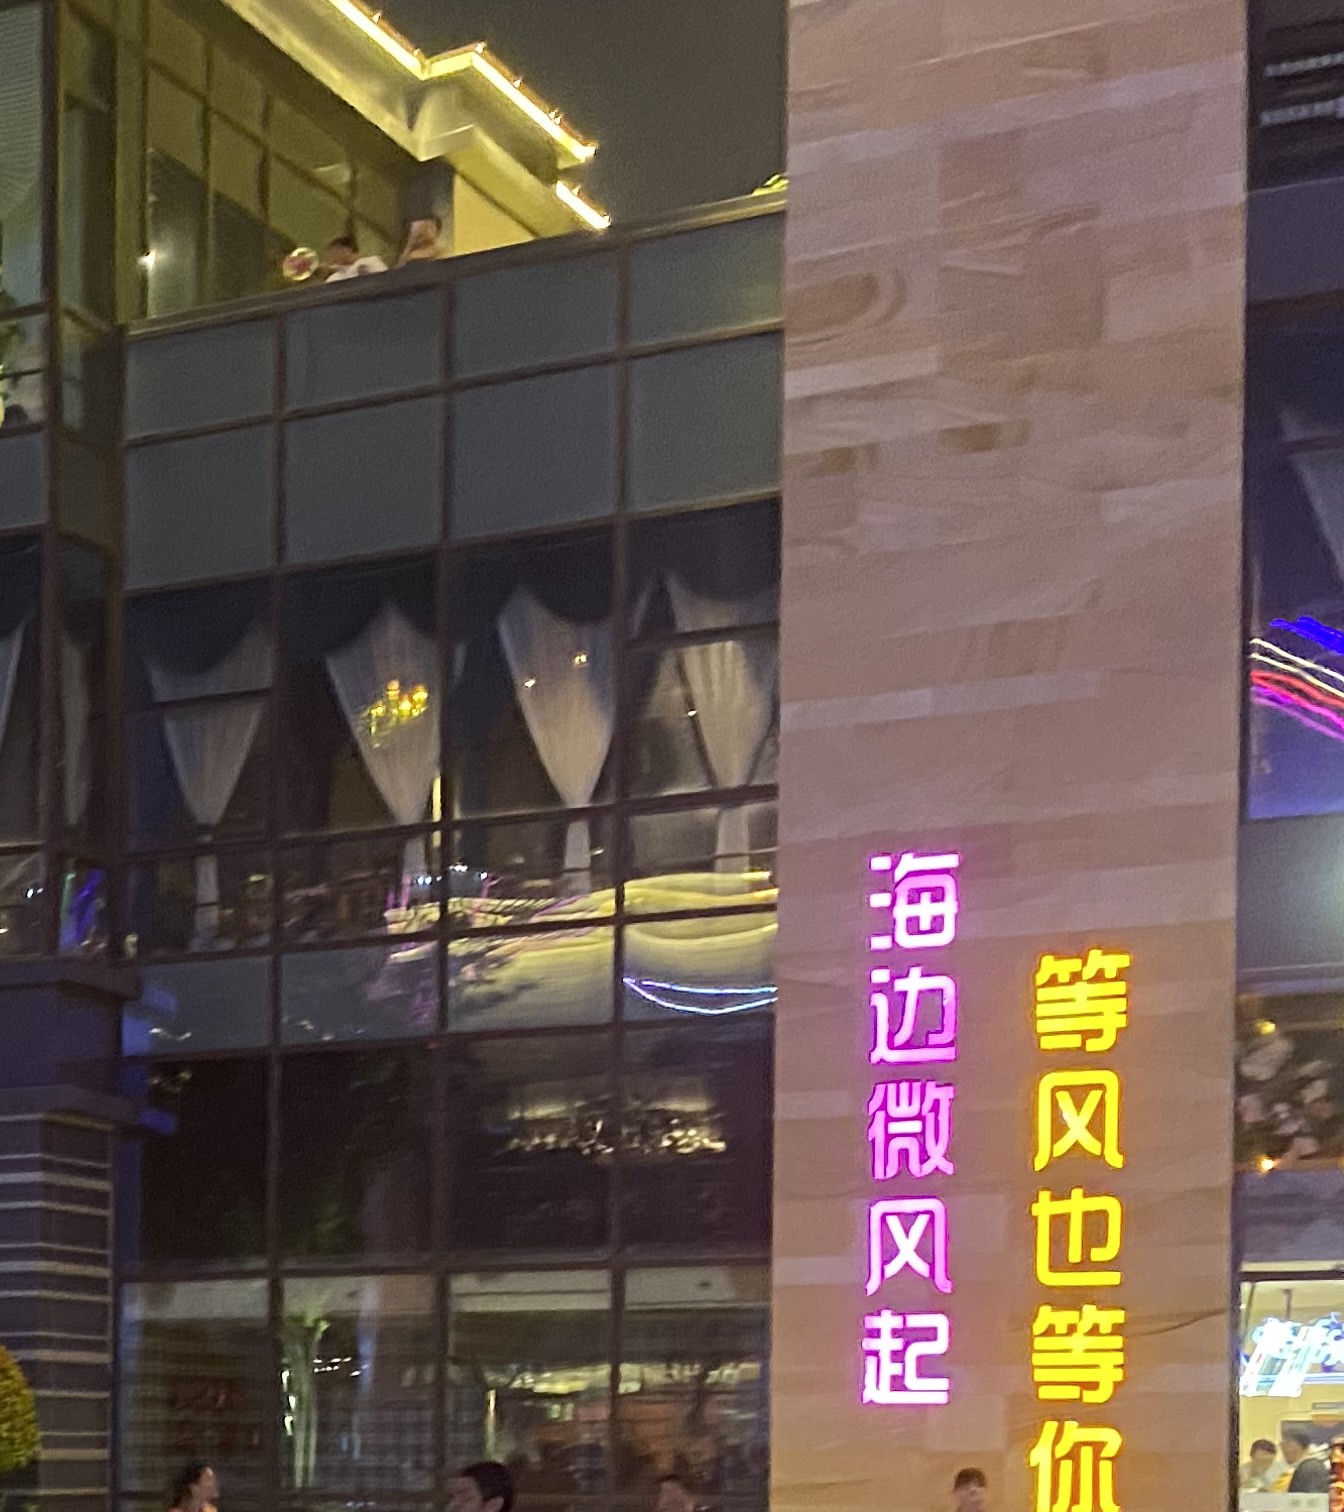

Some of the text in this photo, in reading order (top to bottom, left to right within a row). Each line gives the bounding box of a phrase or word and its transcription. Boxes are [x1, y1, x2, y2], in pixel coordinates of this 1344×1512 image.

[862, 851, 961, 1406] 海边微风起
